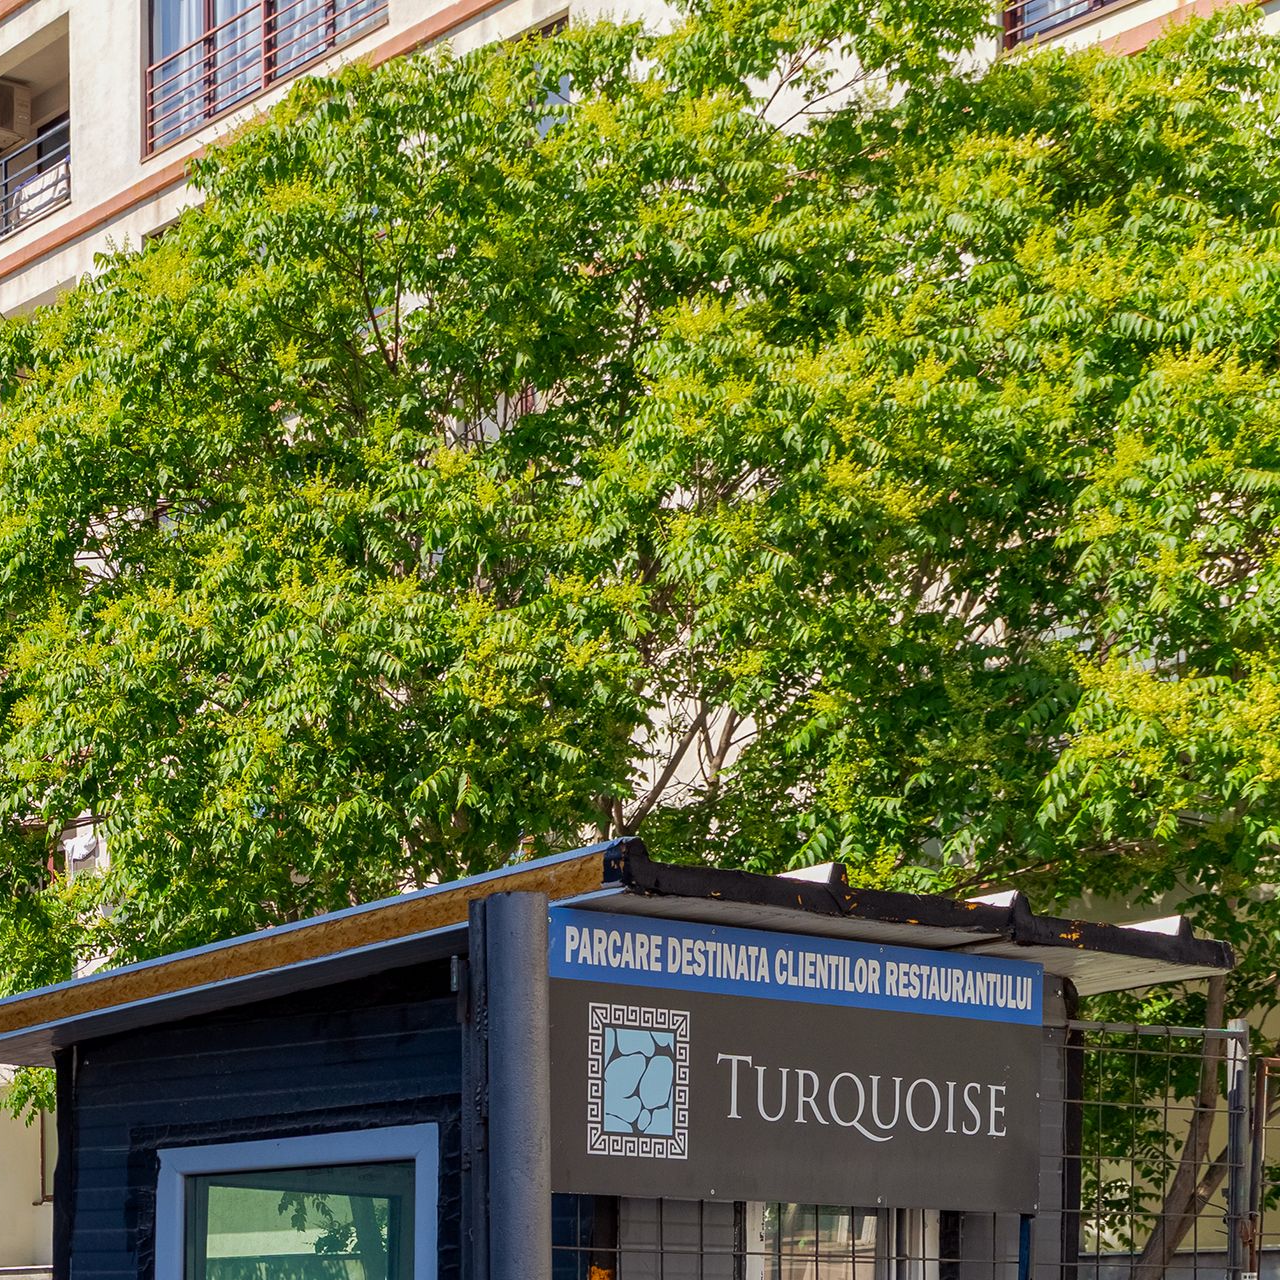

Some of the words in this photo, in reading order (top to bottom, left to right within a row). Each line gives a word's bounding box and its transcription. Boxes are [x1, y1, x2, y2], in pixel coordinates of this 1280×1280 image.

[565, 926, 662, 972] PARCARE
[667, 937, 770, 983] DESTINATA
[774, 949, 881, 994] CLIENTILOR
[885, 962, 1032, 1010] RESTAURANTULUI
[716, 1053, 1007, 1142] TURQUOISE
